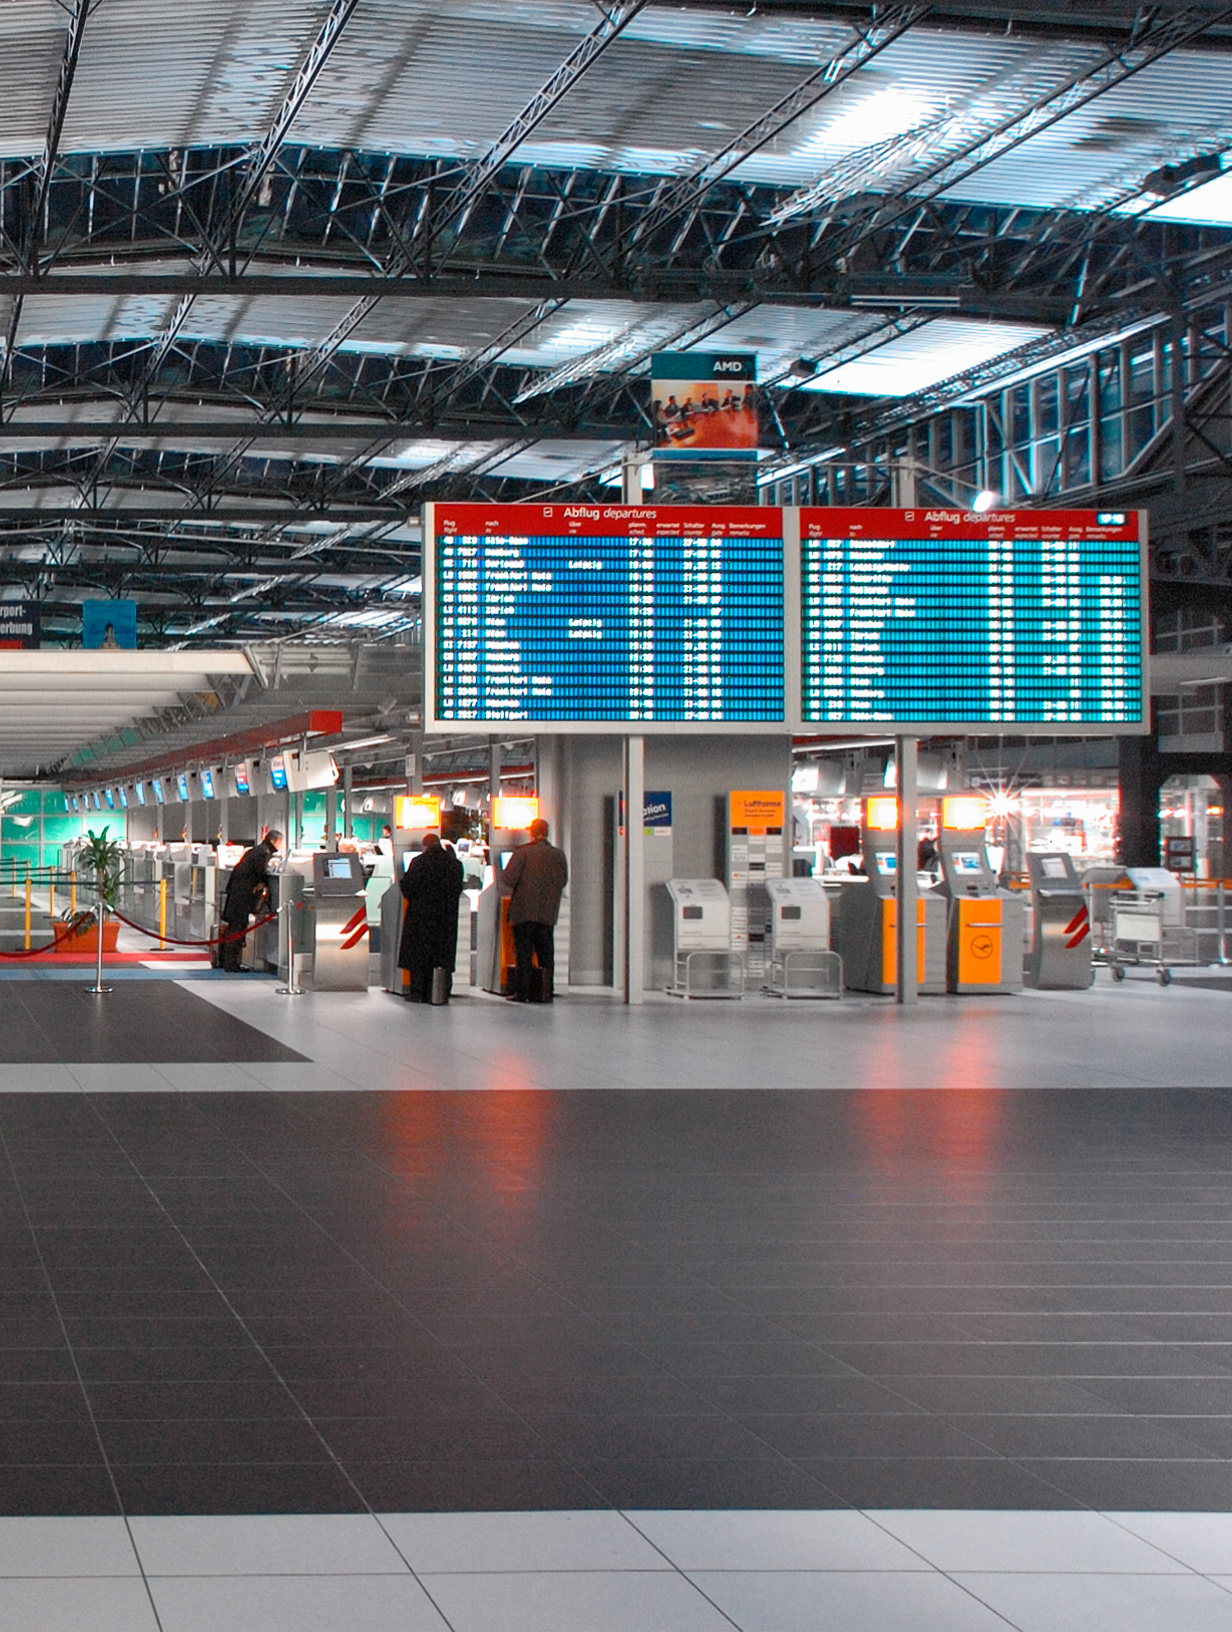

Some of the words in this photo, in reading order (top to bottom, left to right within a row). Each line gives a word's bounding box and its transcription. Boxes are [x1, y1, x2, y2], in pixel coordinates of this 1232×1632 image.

[713, 361, 742, 372] AMD
[564, 507, 599, 520] Abflug
[603, 510, 656, 519] departures
[924, 512, 960, 524] Abflug
[963, 512, 1016, 522] departures
